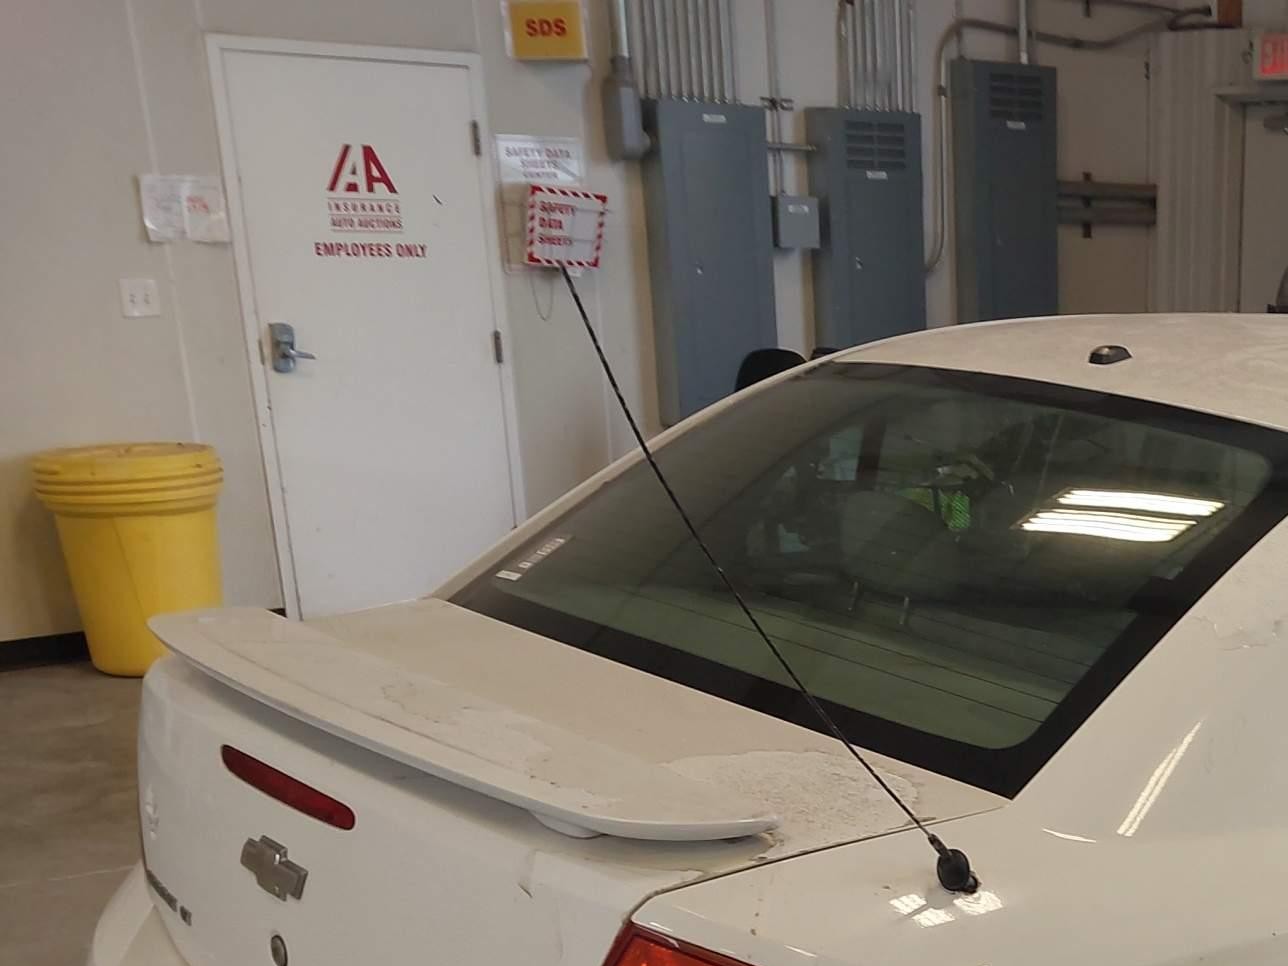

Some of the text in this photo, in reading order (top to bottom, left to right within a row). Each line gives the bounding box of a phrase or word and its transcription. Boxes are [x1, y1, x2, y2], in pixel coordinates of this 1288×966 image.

[526, 18, 567, 37] SDS
[504, 146, 571, 159] SAFETY DATA
[327, 143, 398, 194] IAA
[327, 201, 401, 214] INSURANCE
[539, 201, 576, 216] SAFETY
[330, 216, 403, 229] AUTO AUCTIONS
[539, 217, 563, 230] DATA
[314, 242, 427, 258] EMPLOYEES ONLY
